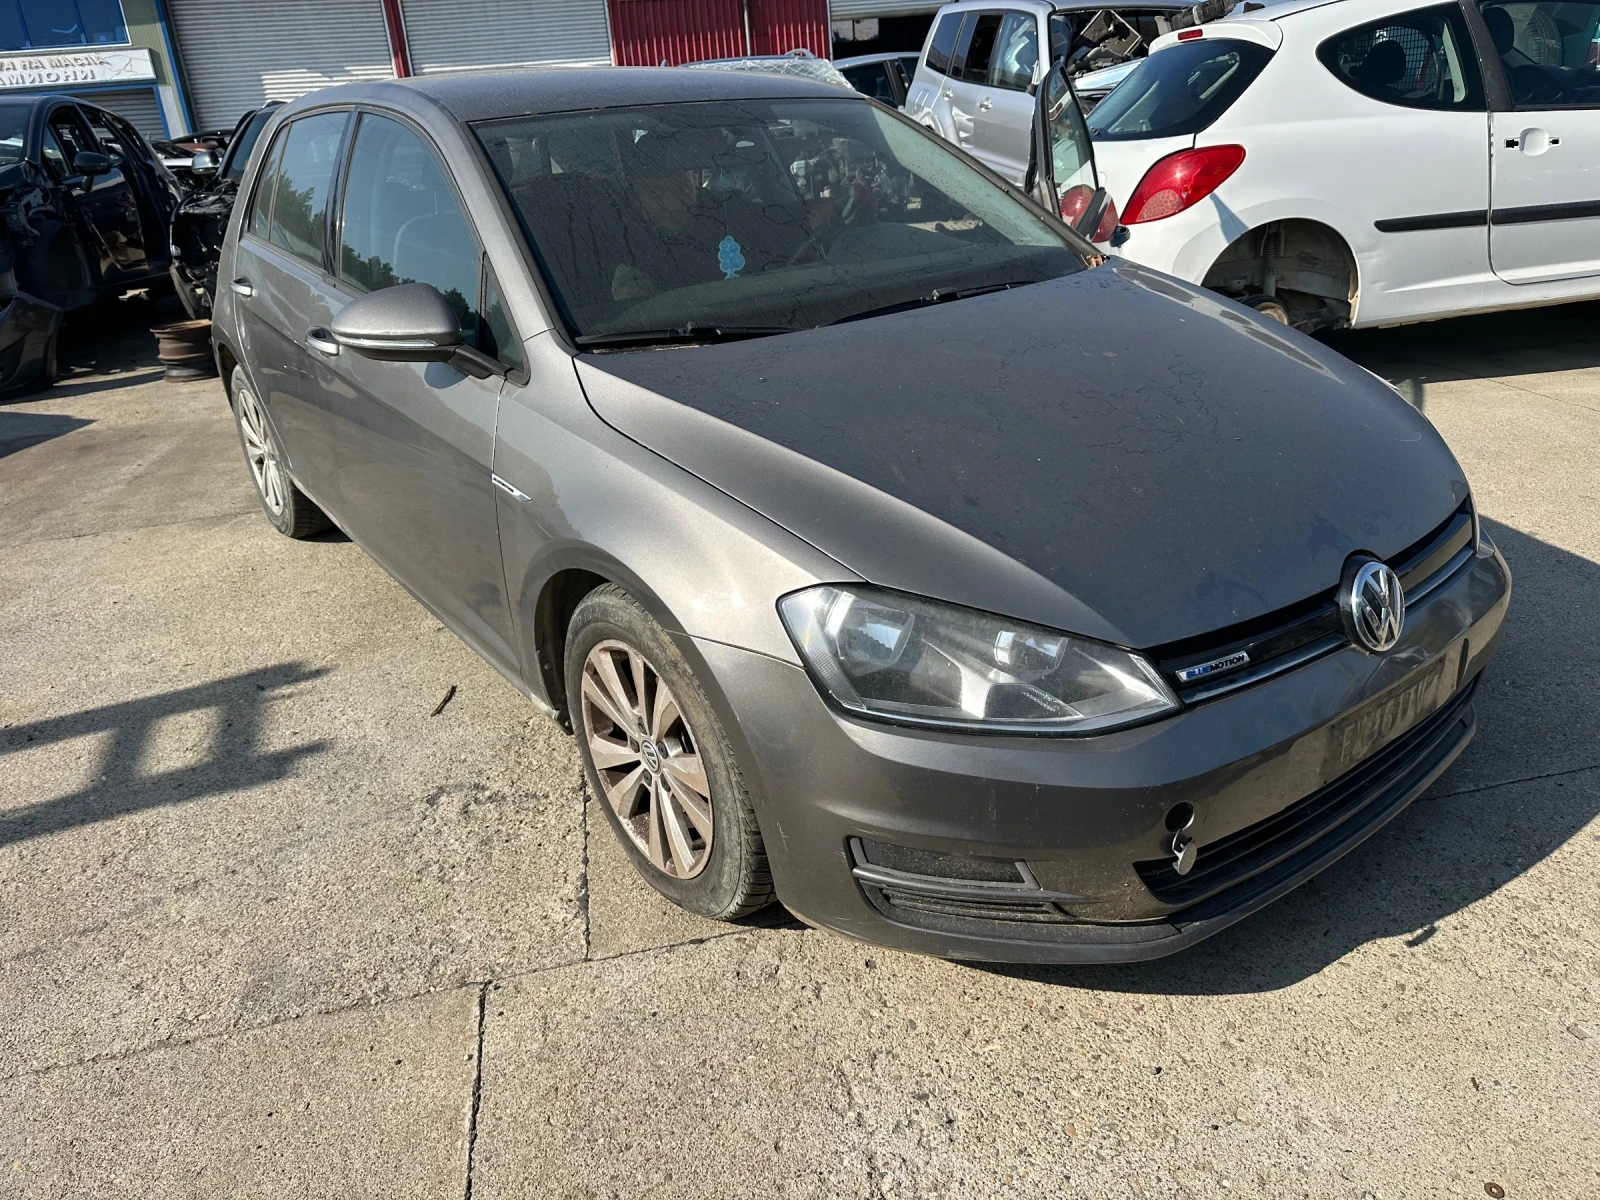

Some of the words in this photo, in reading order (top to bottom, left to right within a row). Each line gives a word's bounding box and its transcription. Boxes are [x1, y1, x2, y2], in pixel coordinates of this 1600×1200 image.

[20, 58, 46, 70] НА
[47, 55, 110, 68] МАСЛА
[1186, 655, 1245, 678] BLUEMOTION
